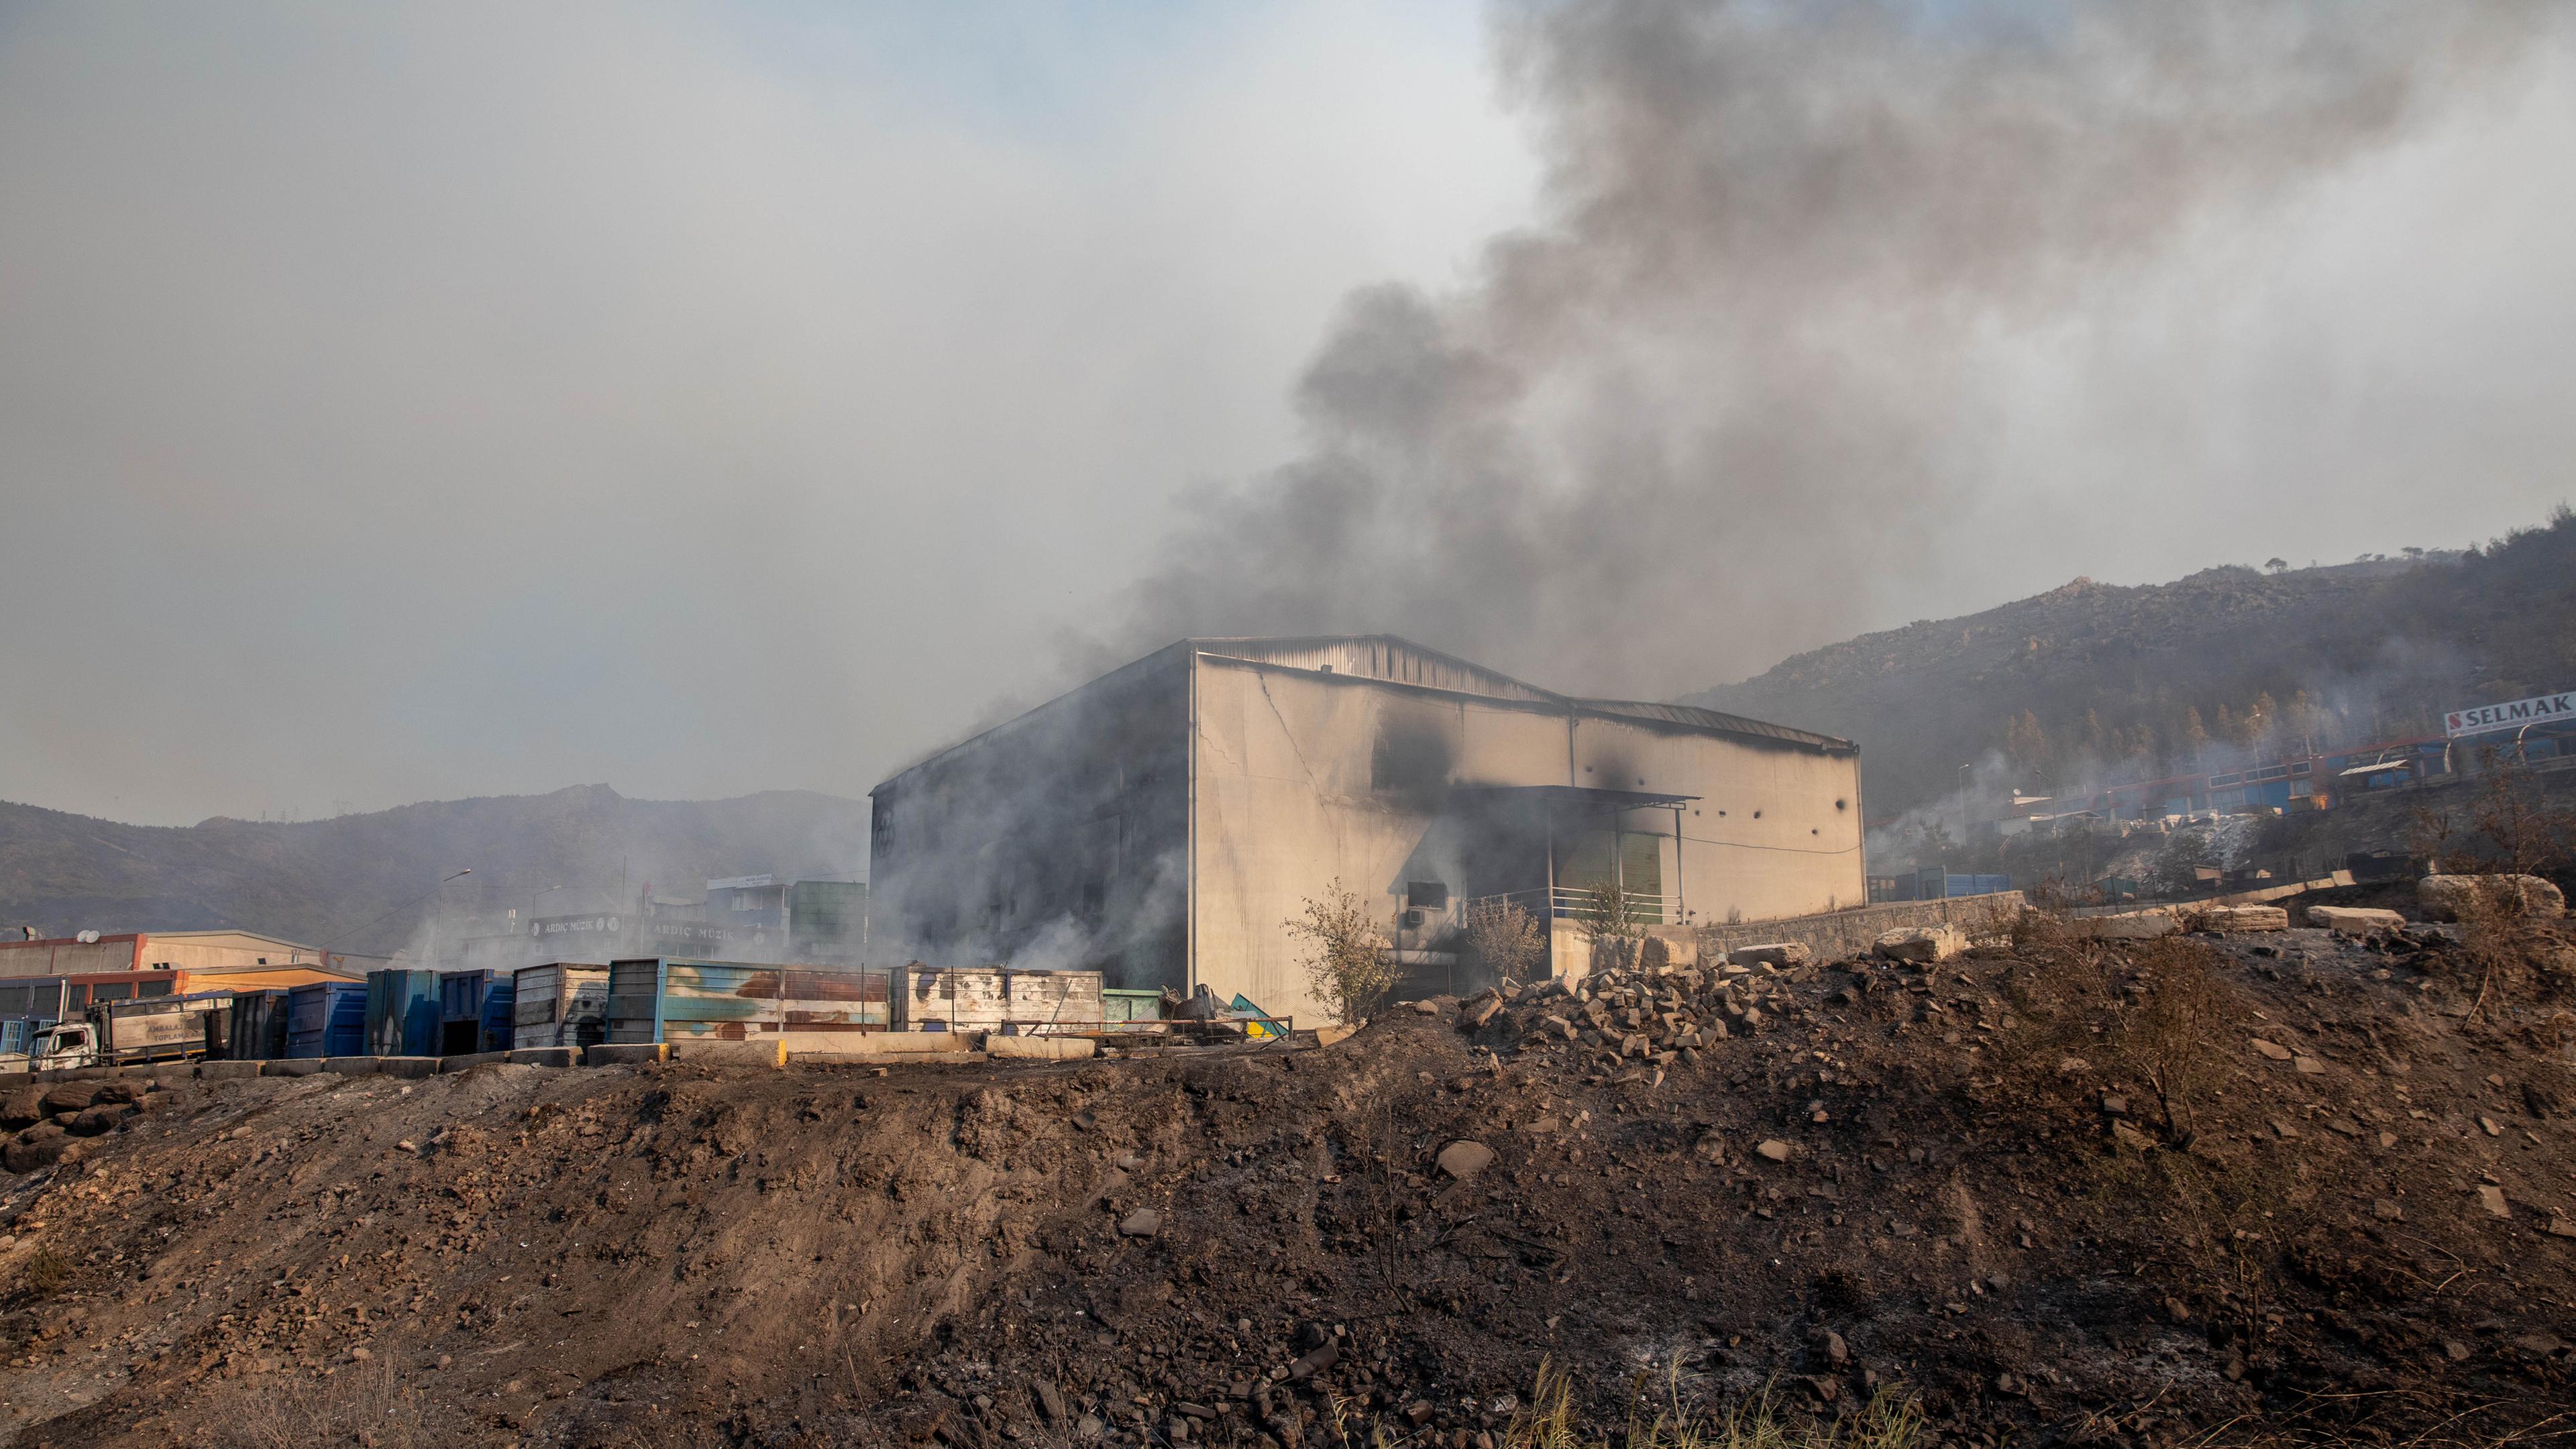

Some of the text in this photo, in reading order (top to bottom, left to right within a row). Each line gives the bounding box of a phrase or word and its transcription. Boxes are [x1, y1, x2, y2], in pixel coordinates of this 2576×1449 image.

[2466, 695, 2572, 727] SELMAK
[147, 1024, 182, 1033] AMBALAJ
[154, 1033, 189, 1041] TOPLAMA
